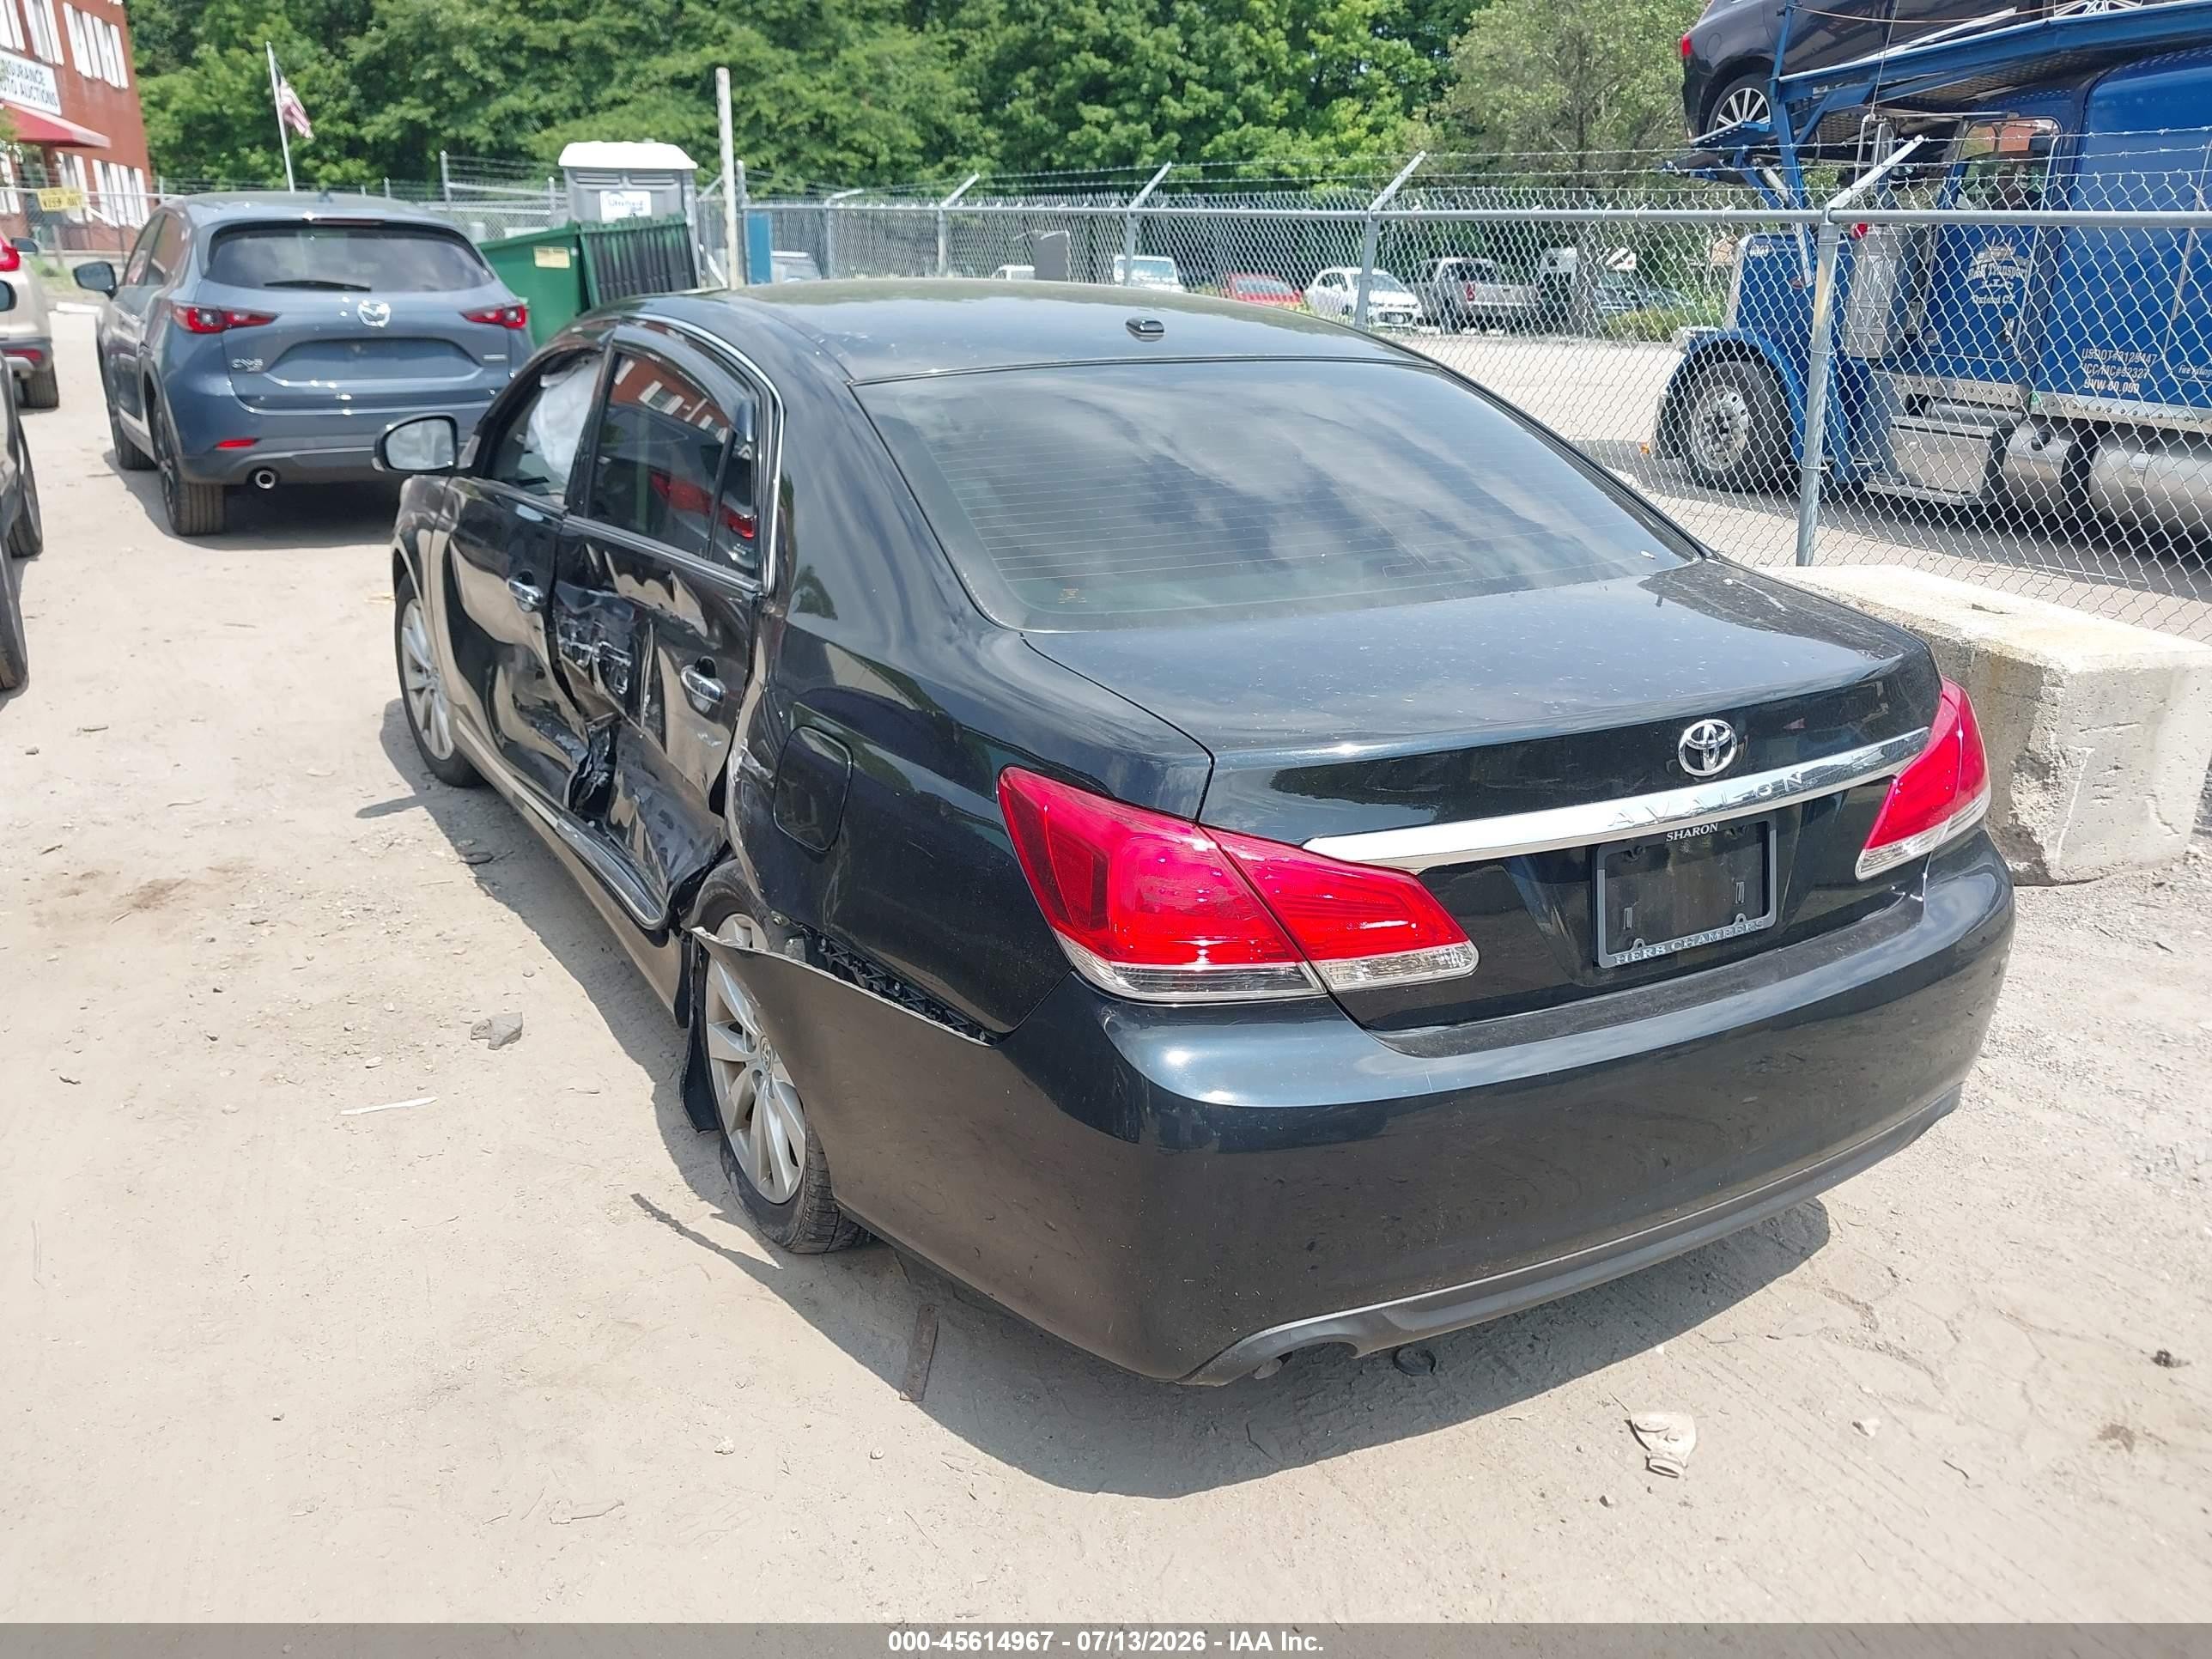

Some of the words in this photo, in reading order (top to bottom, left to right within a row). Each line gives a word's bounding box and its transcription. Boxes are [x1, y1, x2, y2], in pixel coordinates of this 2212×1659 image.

[1607, 770, 1803, 828] AVALON
[1666, 823, 1718, 842] SHARON
[1613, 942, 1666, 966] HERB
[1670, 919, 1764, 951] CHAMBERS
